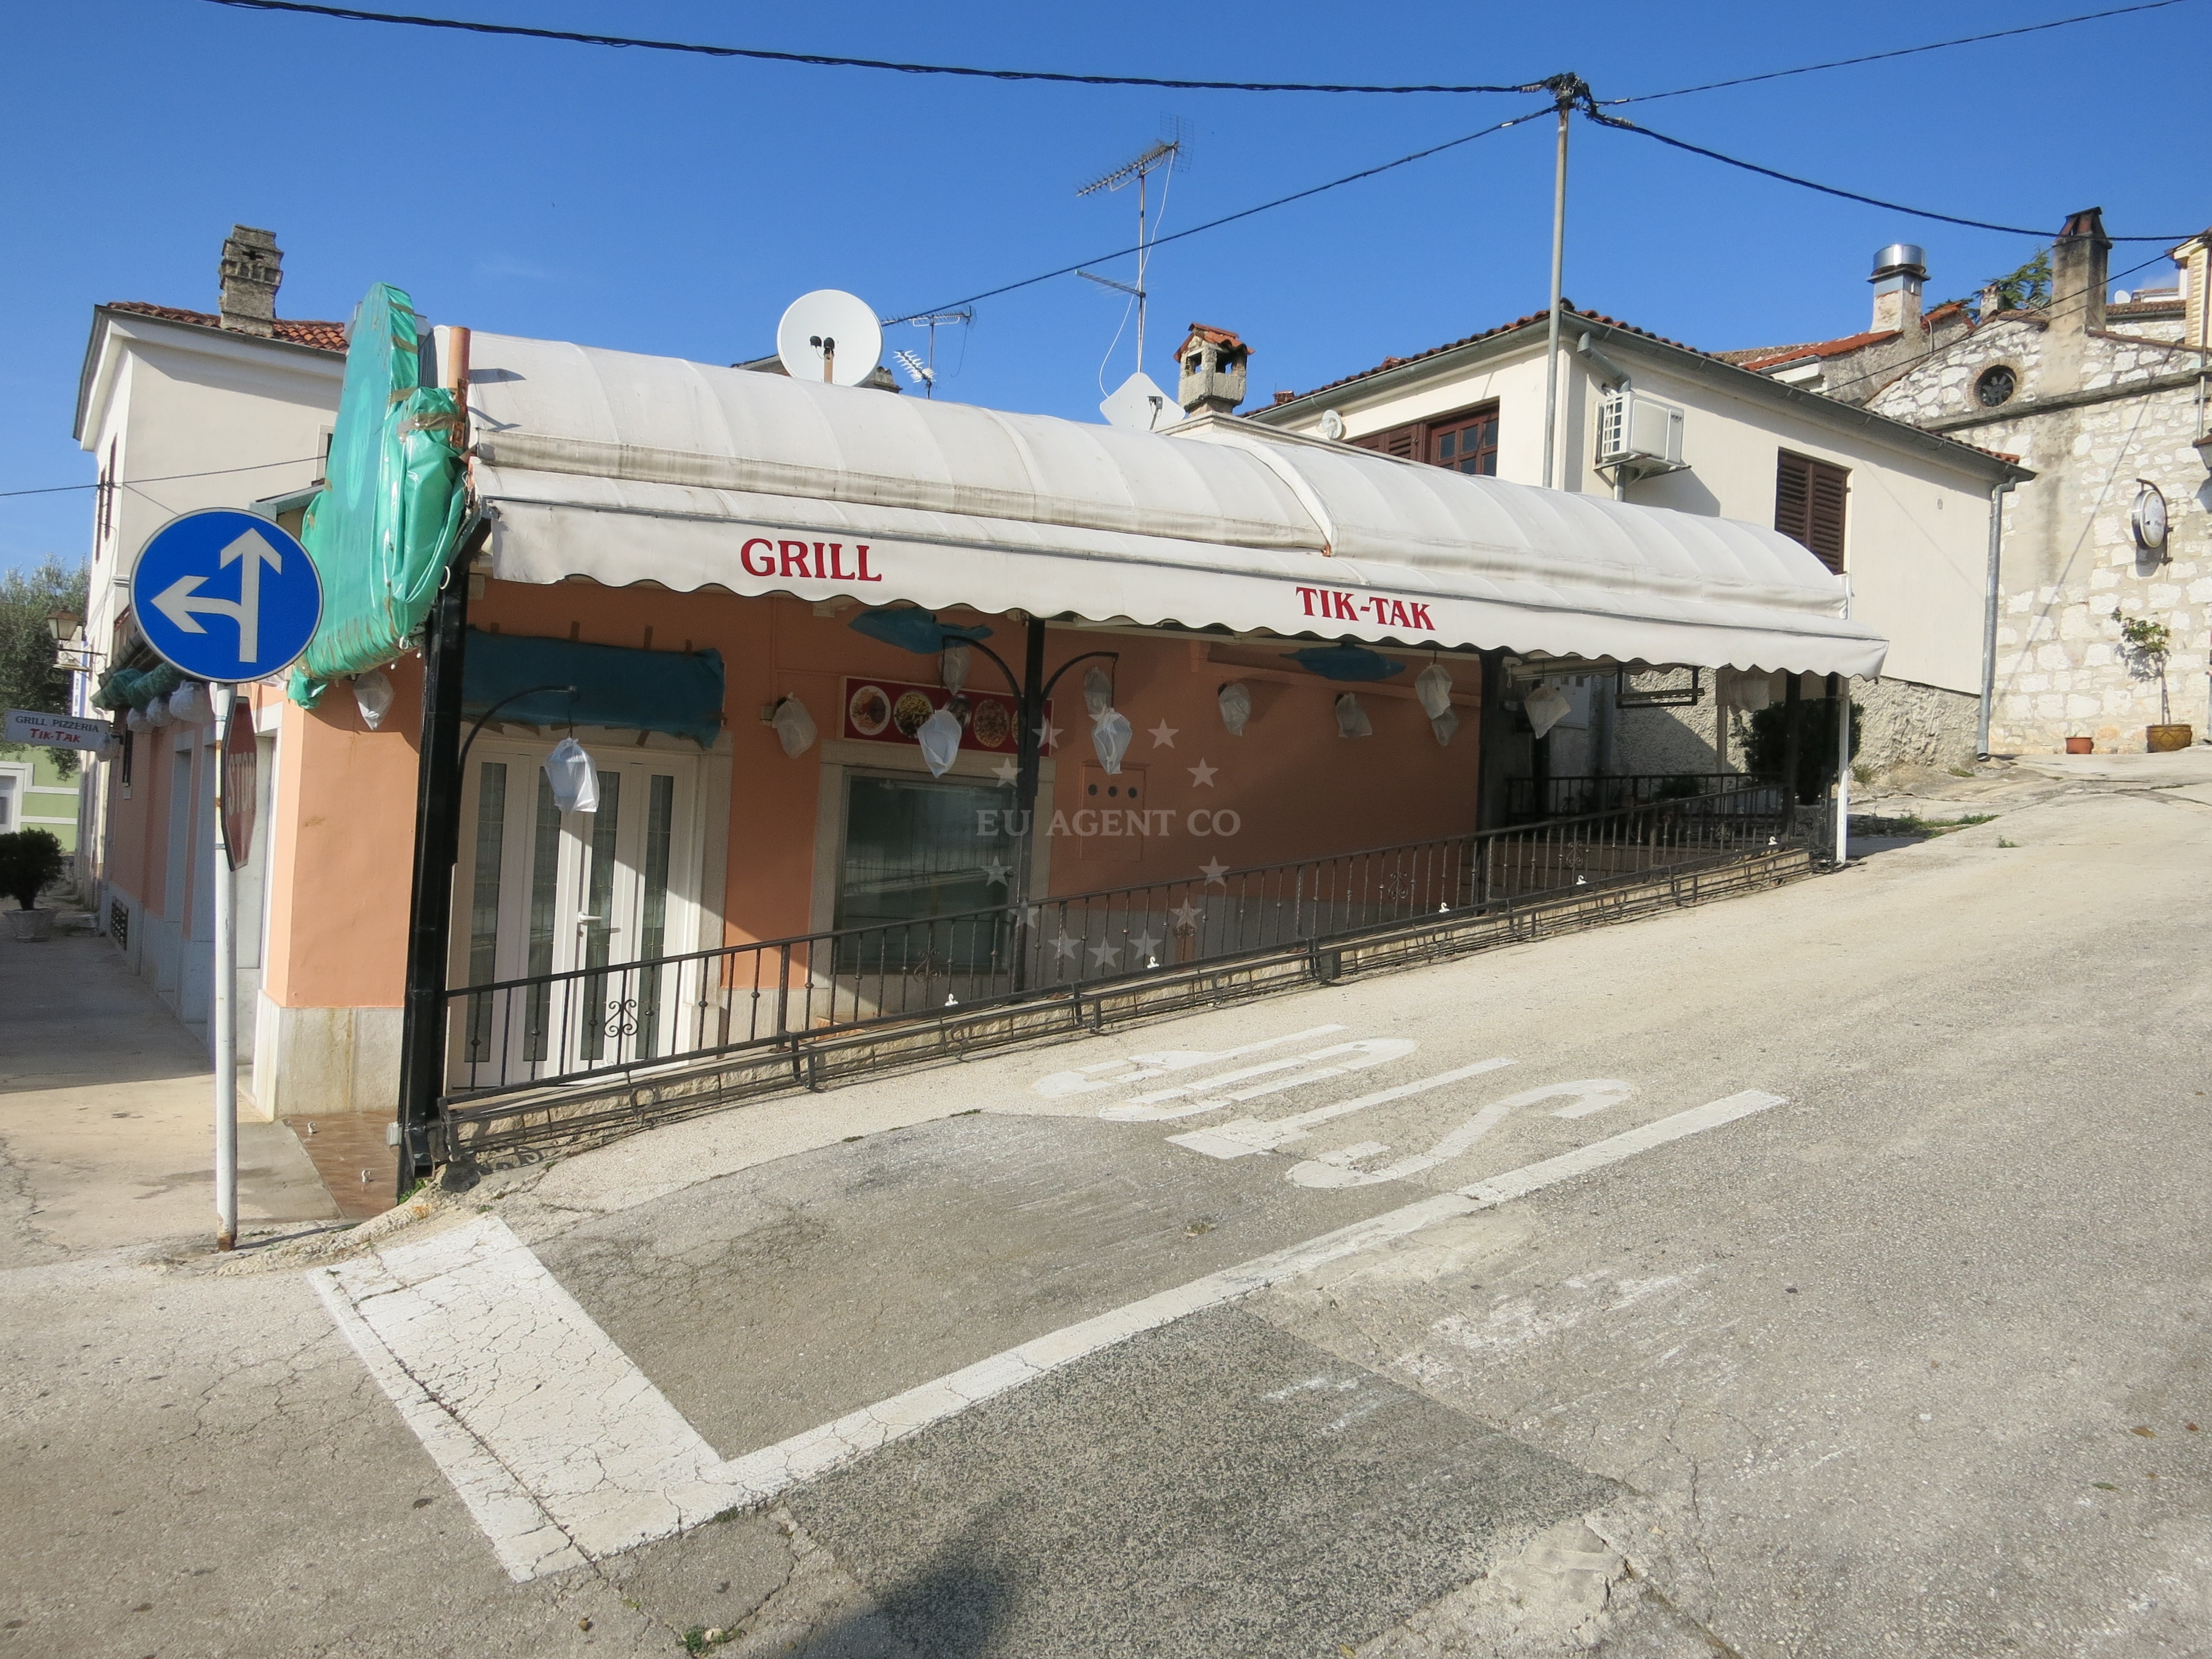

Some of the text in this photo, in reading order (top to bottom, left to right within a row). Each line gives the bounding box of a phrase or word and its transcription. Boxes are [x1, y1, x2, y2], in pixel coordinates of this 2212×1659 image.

[740, 538, 883, 582] GRILL
[1295, 586, 1436, 631] TIK-TAK
[15, 716, 100, 733] GRILL PIZZERIA
[228, 751, 255, 816] STOP
[1030, 1024, 1637, 1189] STOP
